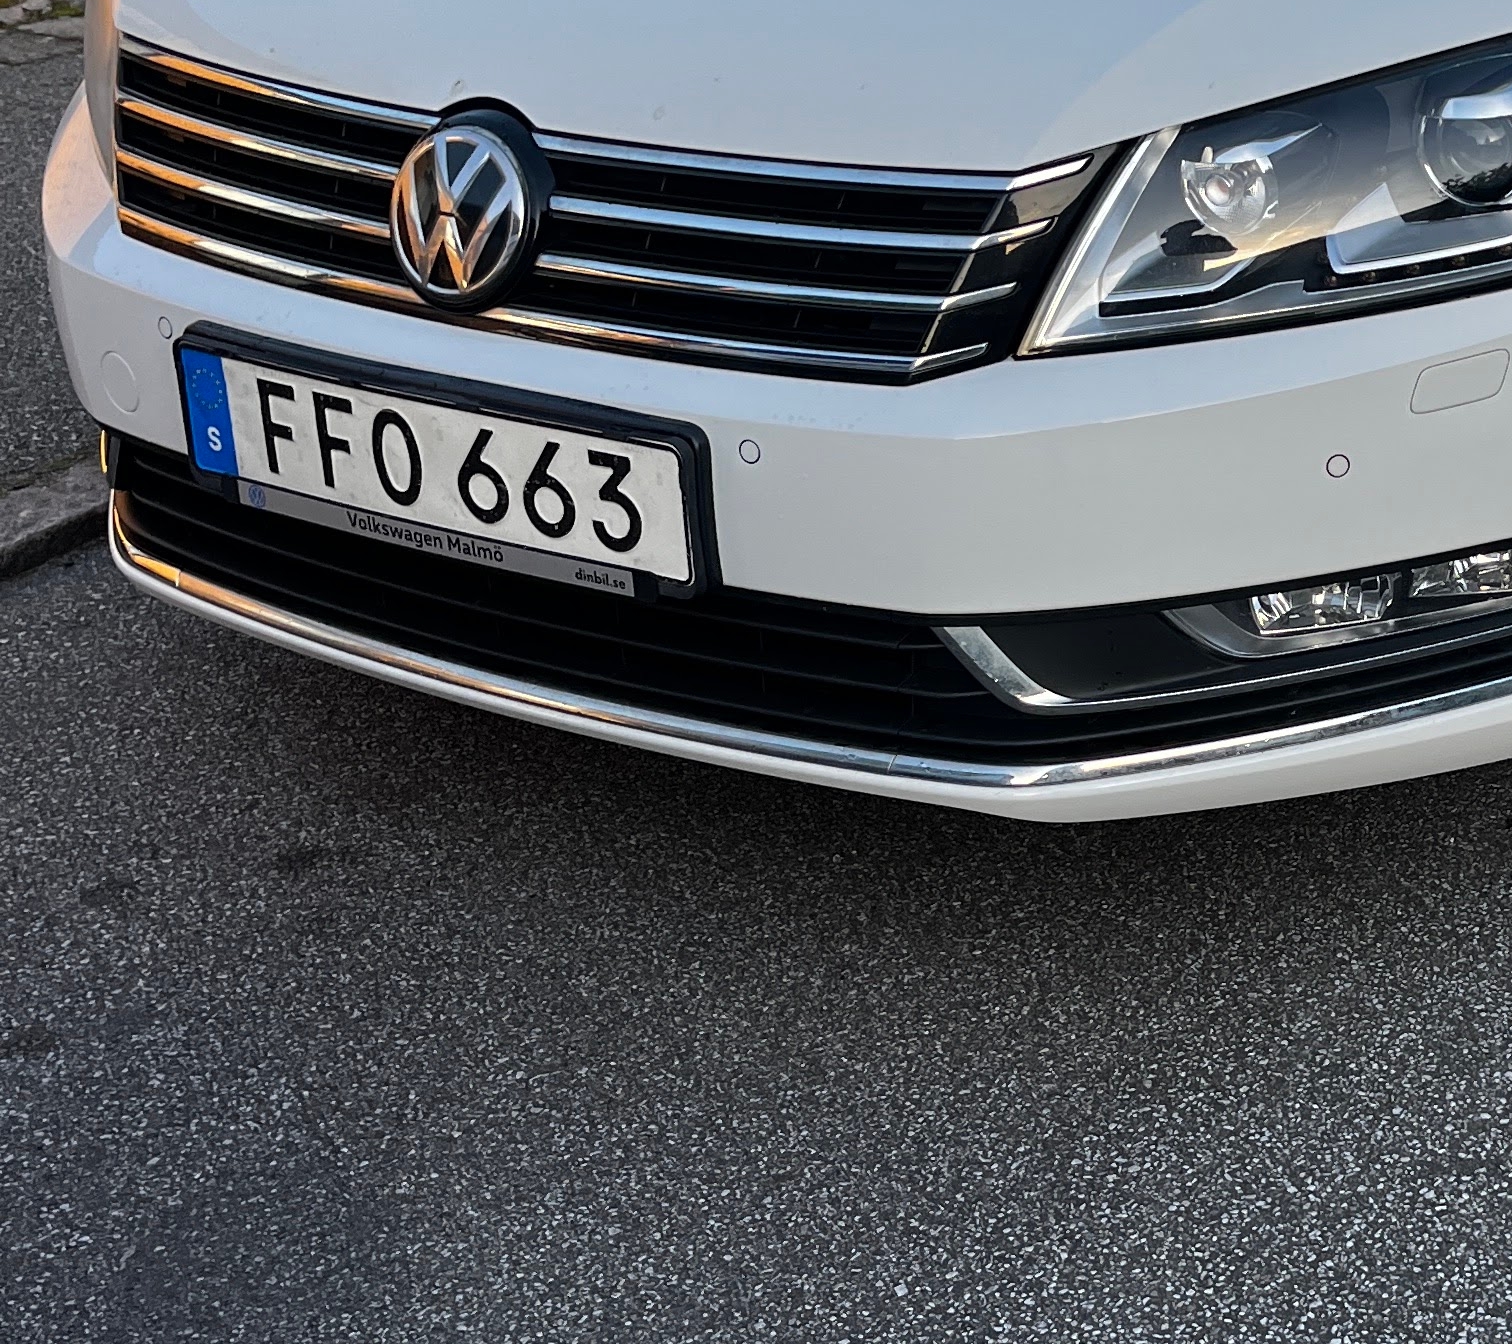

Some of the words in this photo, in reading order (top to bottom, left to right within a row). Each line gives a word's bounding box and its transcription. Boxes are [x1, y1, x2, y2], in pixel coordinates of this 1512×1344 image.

[207, 426, 222, 452] S
[256, 377, 422, 506] FFO
[457, 428, 643, 553] 663
[346, 510, 444, 549] Volkswagen
[446, 534, 504, 563] Malmö
[574, 567, 627, 590] dinbil.se
